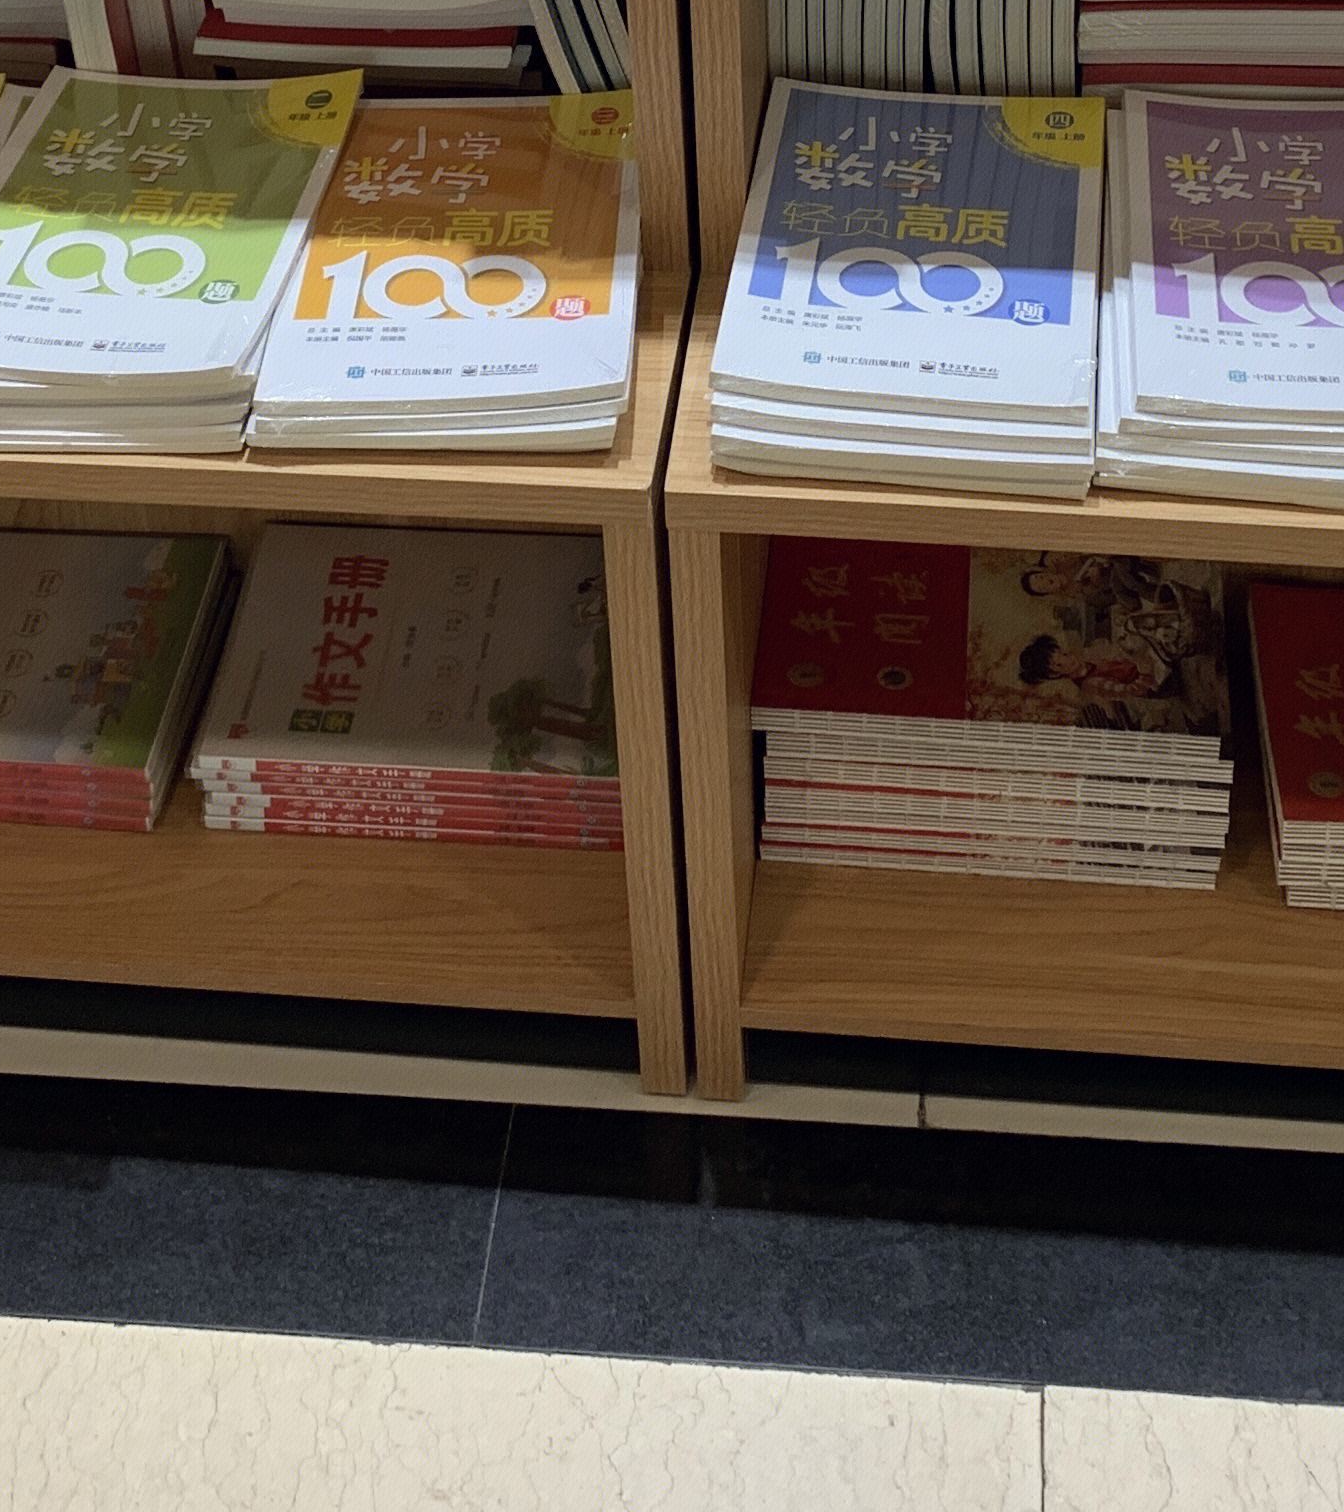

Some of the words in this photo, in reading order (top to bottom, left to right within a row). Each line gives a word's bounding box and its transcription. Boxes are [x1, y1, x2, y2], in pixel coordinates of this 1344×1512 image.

[101, 103, 214, 141] 小学
[388, 125, 502, 161] 小学
[838, 116, 954, 155] 小学
[1207, 126, 1324, 166] 小学
[44, 128, 190, 184] 数学
[793, 139, 945, 200] 数学
[343, 157, 491, 205] 数学
[1164, 154, 1324, 213] 数学
[13, 185, 238, 231] 轻负高质
[330, 208, 555, 248] 轻负高质
[780, 199, 1011, 248] 轻负高质
[199, 280, 240, 303] 题
[323, 251, 548, 320] 100
[550, 296, 590, 320] 题
[775, 234, 1005, 318] 100
[1010, 298, 1050, 326] 题
[302, 554, 390, 707] 作文手册
